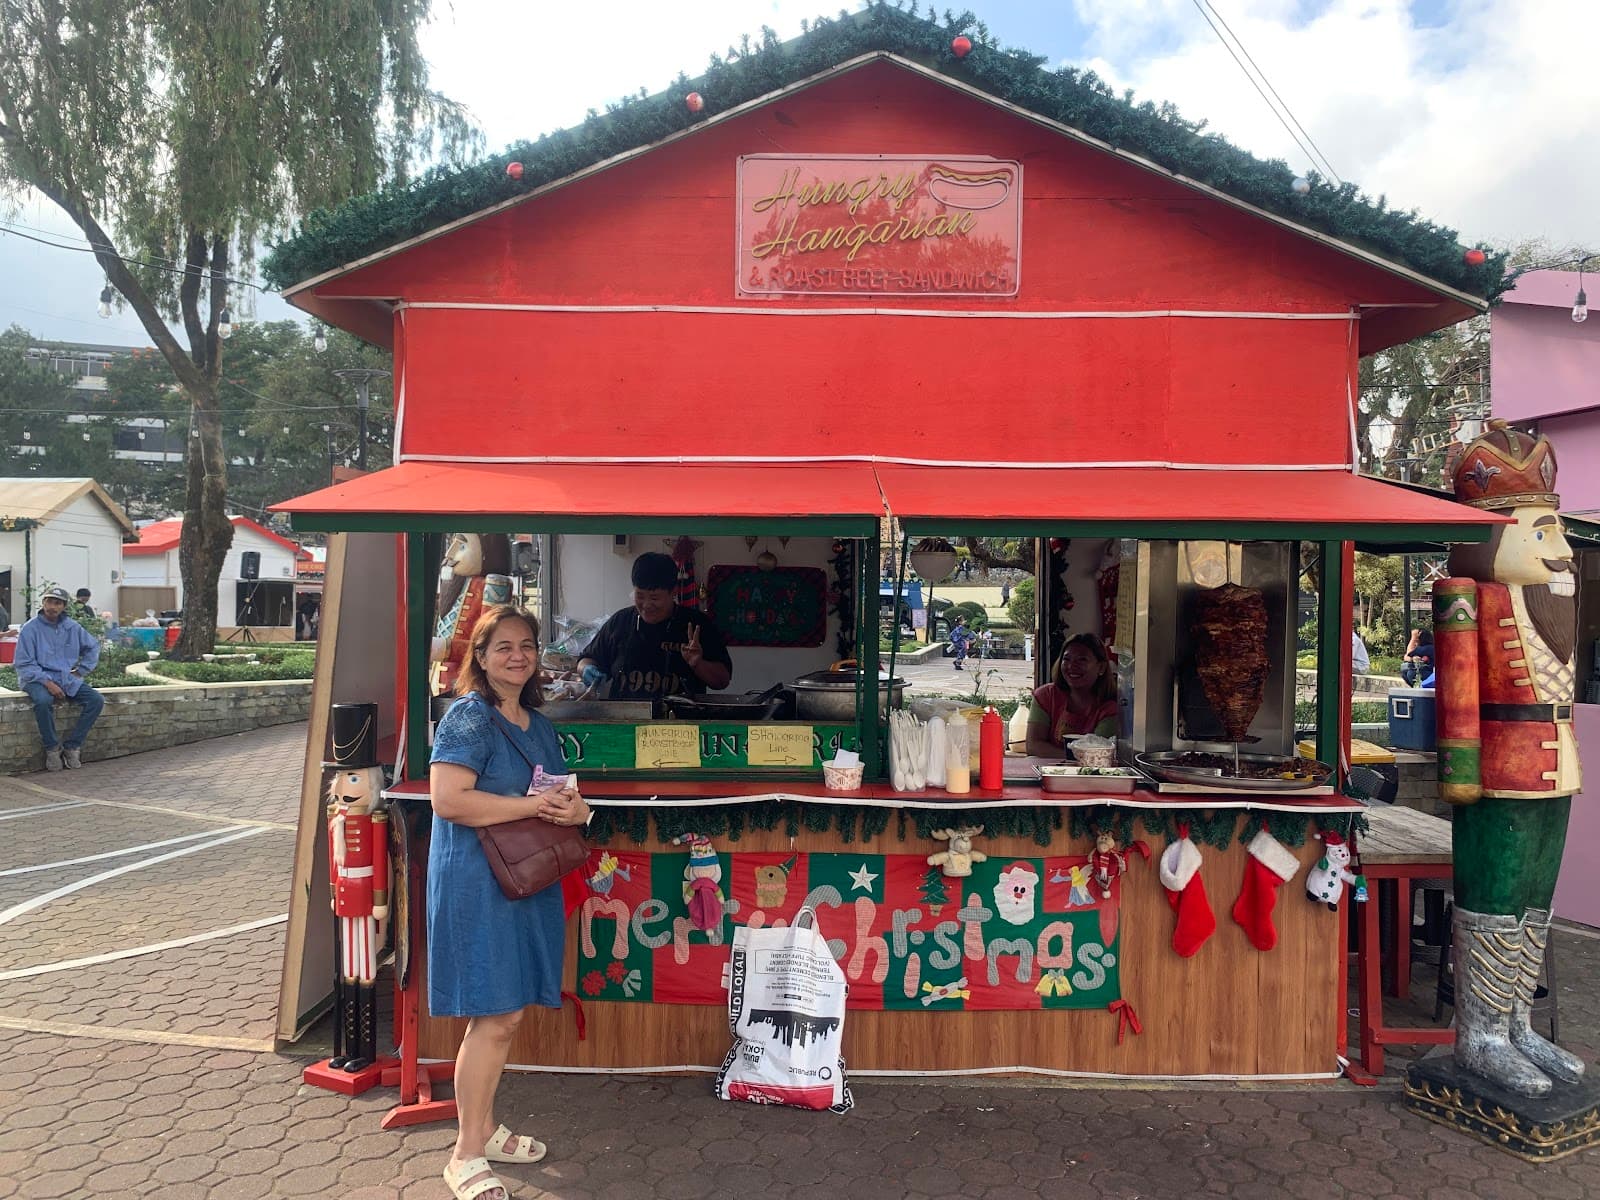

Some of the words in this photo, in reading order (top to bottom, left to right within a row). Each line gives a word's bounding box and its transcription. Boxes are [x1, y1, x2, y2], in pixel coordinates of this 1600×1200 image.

[752, 166, 916, 215] Hungry
[751, 210, 978, 262] Hangarian
[749, 265, 764, 287] &
[768, 266, 834, 288] ROAST
[842, 268, 889, 289] BEEF
[898, 268, 1011, 291] SANDWICH
[733, 953, 745, 994] LOKAL
